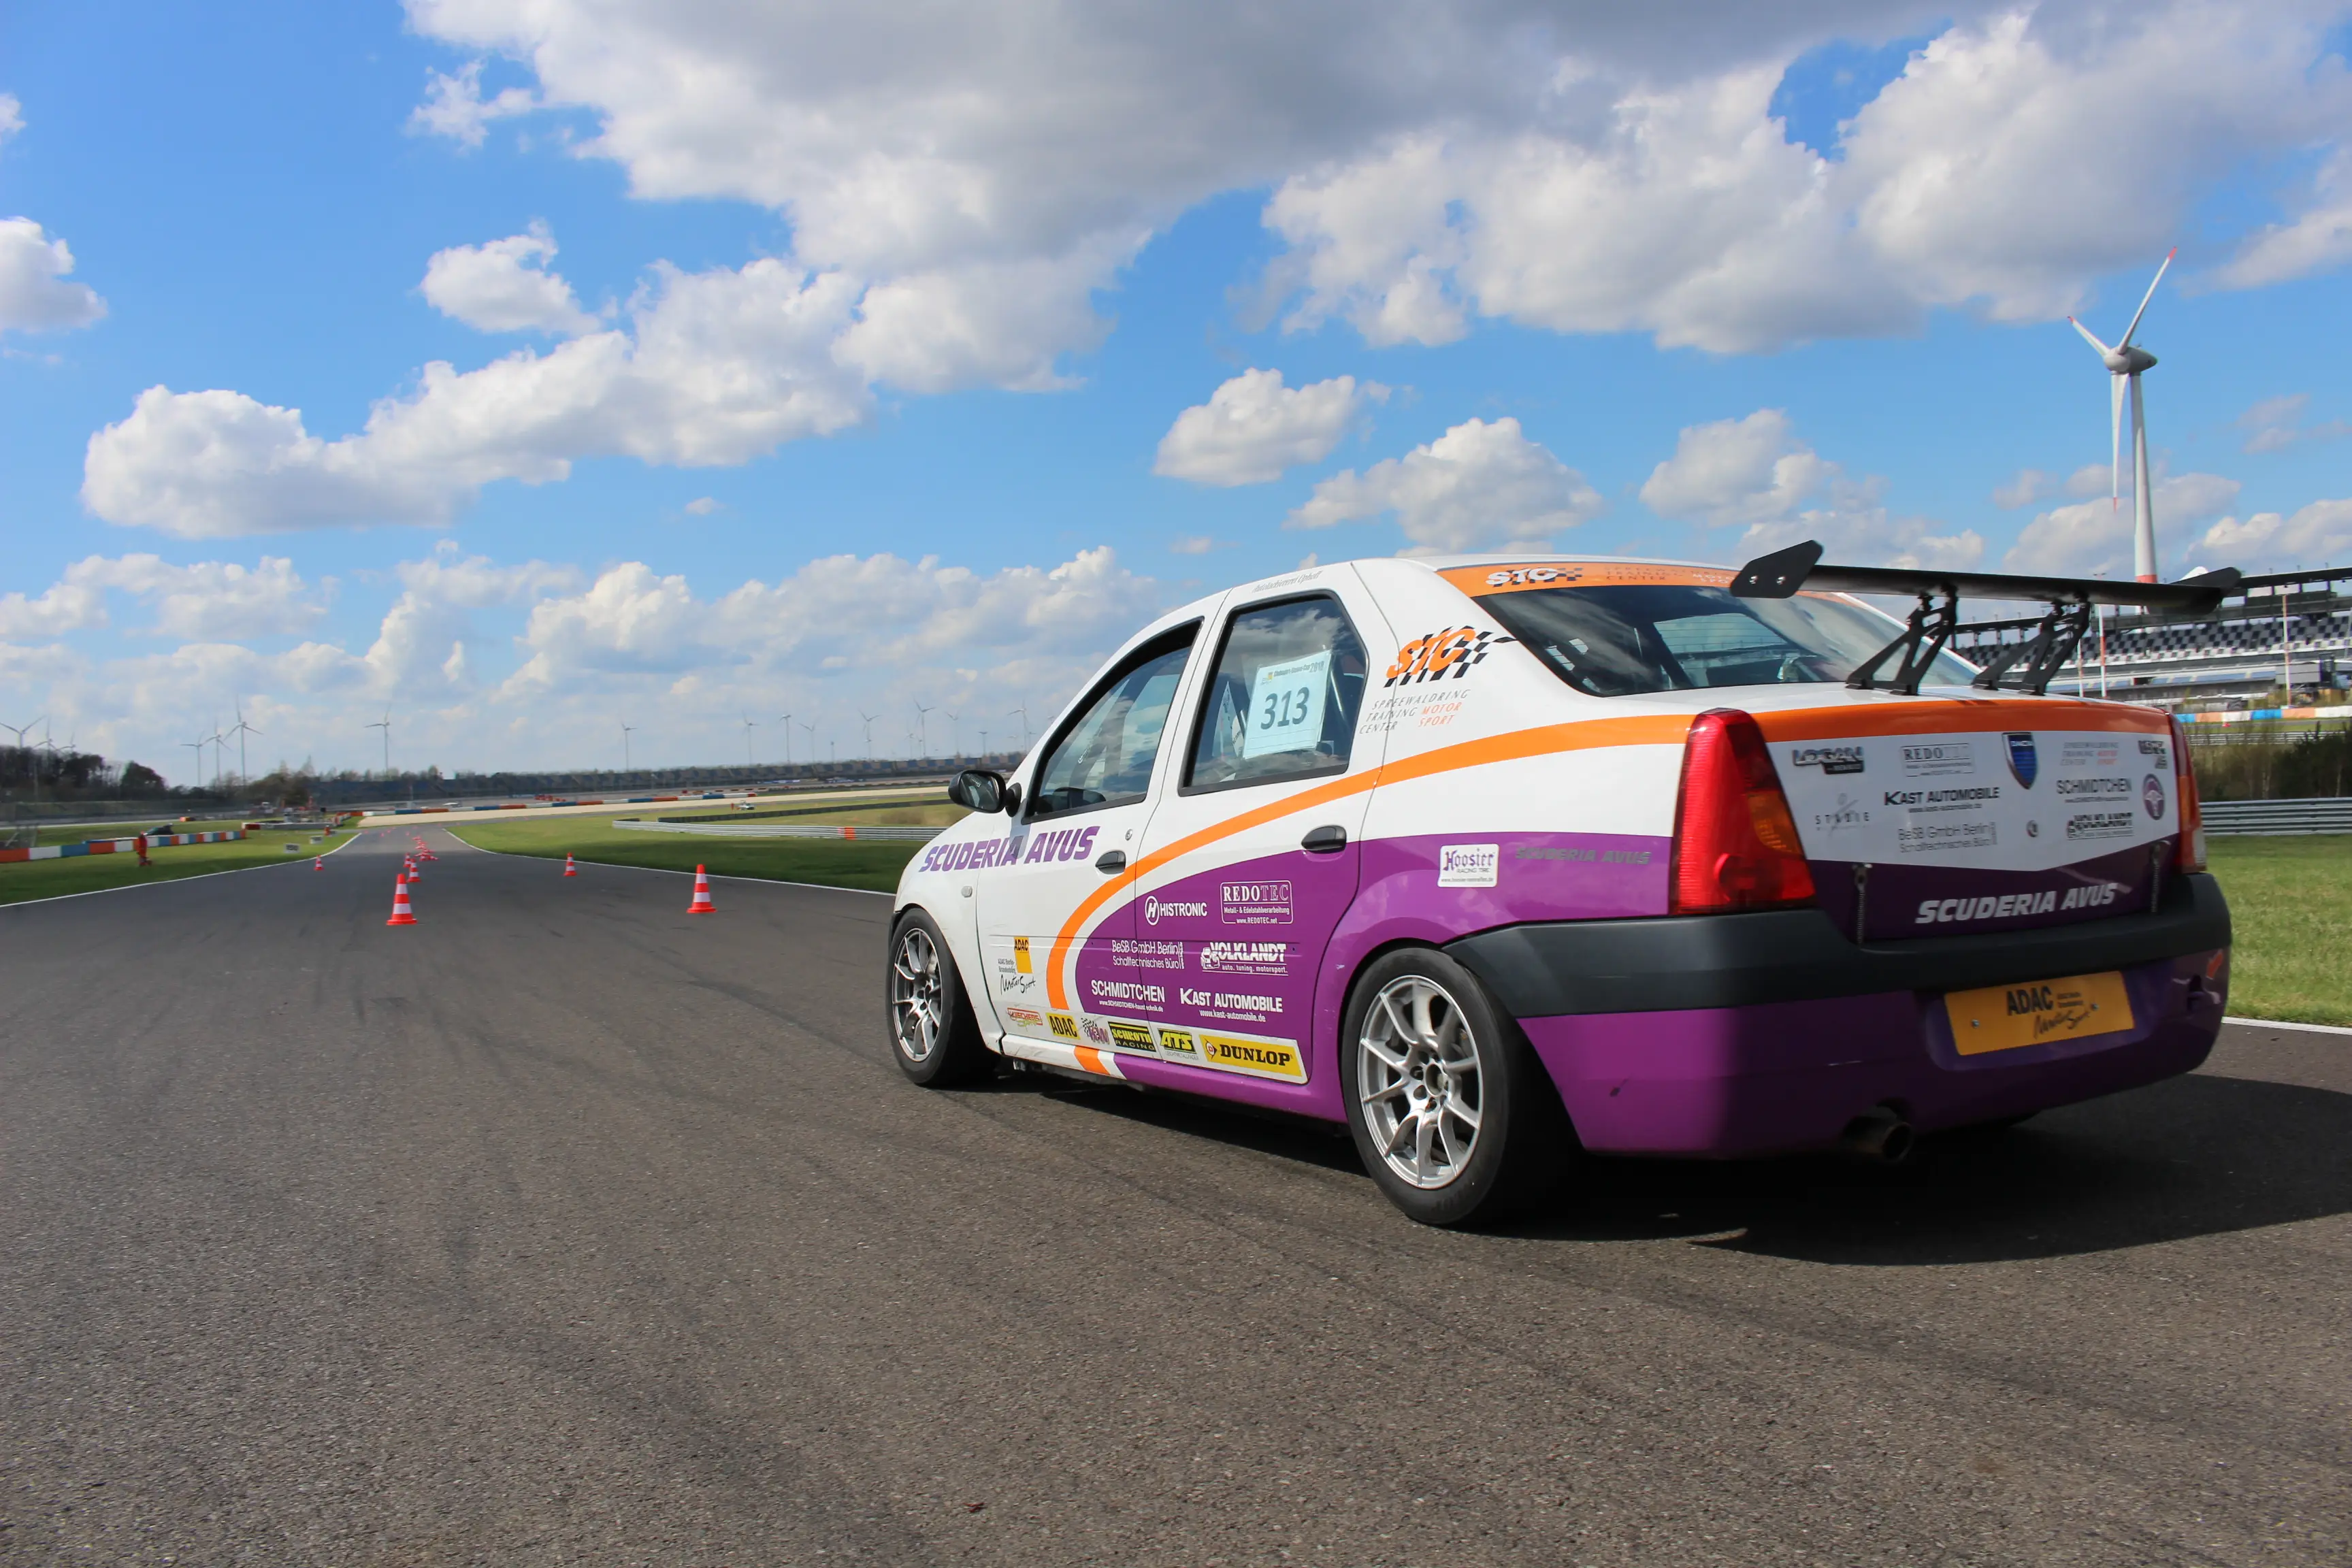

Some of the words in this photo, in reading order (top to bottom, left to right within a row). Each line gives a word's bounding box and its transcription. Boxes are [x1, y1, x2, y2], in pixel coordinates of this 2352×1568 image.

[1486, 568, 1558, 585] STC
[1386, 628, 1477, 679] STC
[1260, 687, 1310, 730] 313
[1372, 689, 1471, 710] SPREEWALDRING
[1366, 706, 1418, 723] TRAINING
[1421, 702, 1463, 715] MOTOR
[1359, 721, 1398, 734] CENTER
[1418, 715, 1455, 728] SPORT
[1926, 787, 2000, 803] AUTOMOBILE
[918, 835, 1024, 873] SCUDERIA
[1024, 826, 1100, 864] AVUS
[1443, 848, 1494, 871] Hoosier
[1516, 847, 1597, 862] SCUDERIA
[1601, 851, 1652, 865] AVUS
[1223, 885, 1289, 902] REDOTEC
[1914, 890, 2057, 924] SCUDERIA
[2060, 882, 2119, 911] AVUS
[1160, 902, 1208, 917] HISTRONIC
[1014, 939, 1028, 951] ADAC
[1111, 939, 1130, 953] BeSB
[1130, 940, 1156, 954] GmbH
[1157, 941, 1178, 955] Berlin
[1210, 942, 1286, 962] VOLKLANDT
[1164, 958, 1179, 969] Büro
[1091, 979, 1165, 1003] SCHMIDTCHEN
[1179, 987, 1211, 1007] KAST
[1214, 993, 1284, 1013] AUTOMOBILE
[2006, 985, 2053, 1016] ADAC
[1049, 1015, 1078, 1038] ADAC
[1111, 1028, 1153, 1044] SCHROTH
[1115, 1040, 1155, 1051] RACING
[1160, 1031, 1193, 1051] ATS
[1219, 1043, 1290, 1066] DUNLOP
